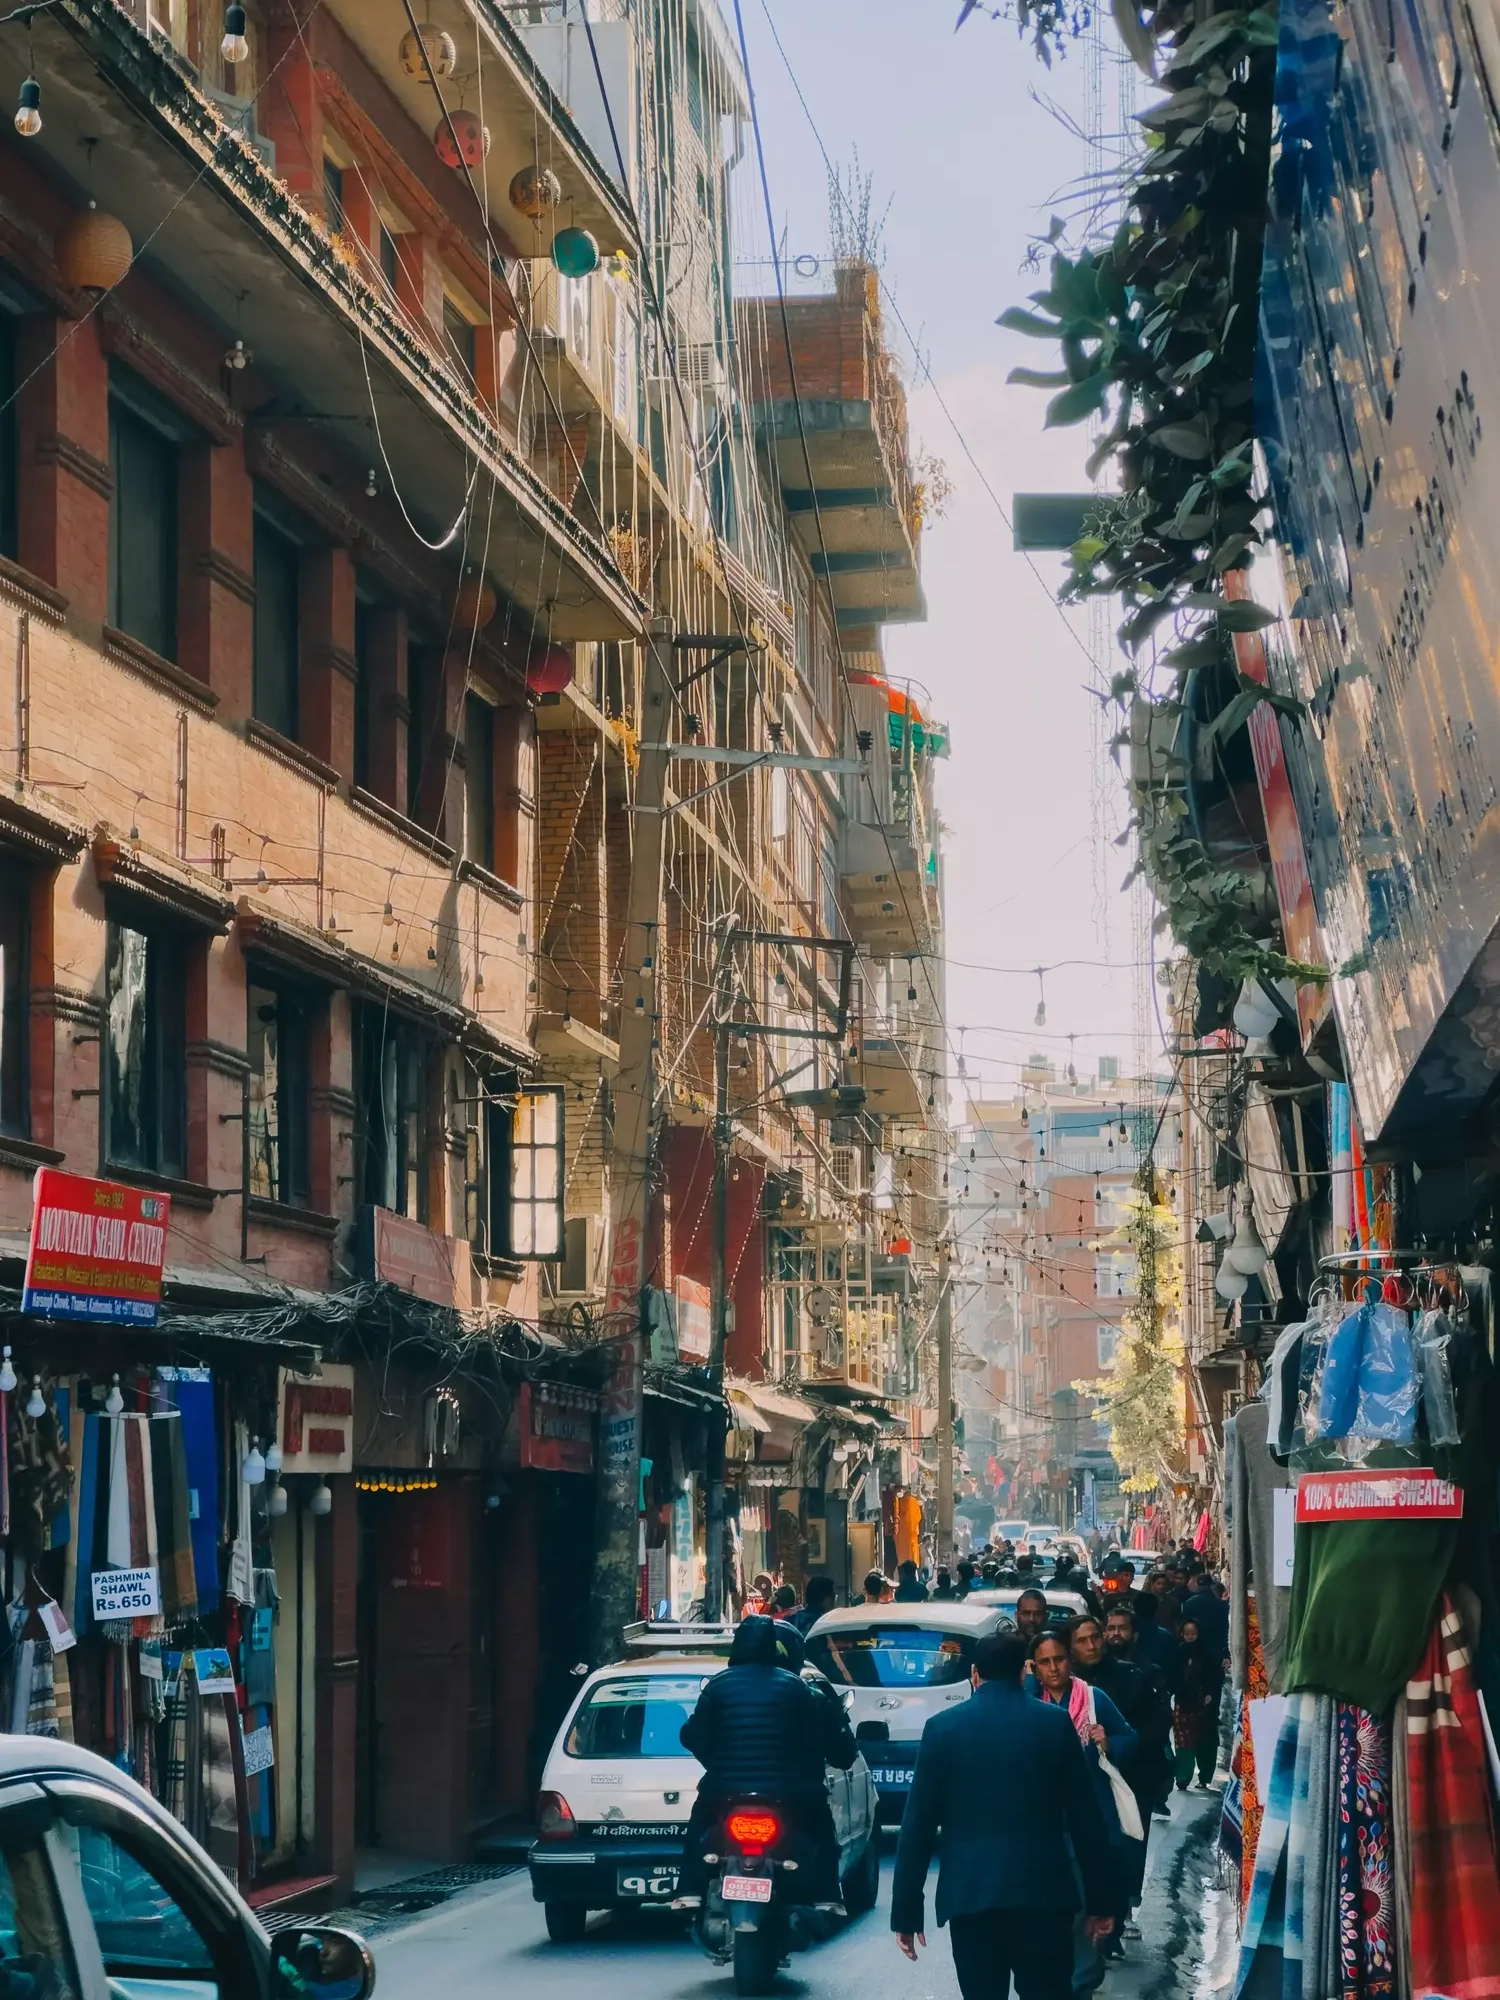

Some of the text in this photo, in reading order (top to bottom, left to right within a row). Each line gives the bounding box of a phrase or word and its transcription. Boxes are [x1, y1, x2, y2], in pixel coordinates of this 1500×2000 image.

[37, 1206, 164, 1267] MOUNTAIN SHAWL CENTER
[1305, 1478, 1456, 1511] 100% CASHMERE SWEATER
[94, 1572, 151, 1585] PASHMINA
[100, 1582, 146, 1595] SHAWL
[96, 1593, 152, 1611] Rs.650
[592, 1825, 608, 1836] श्री
